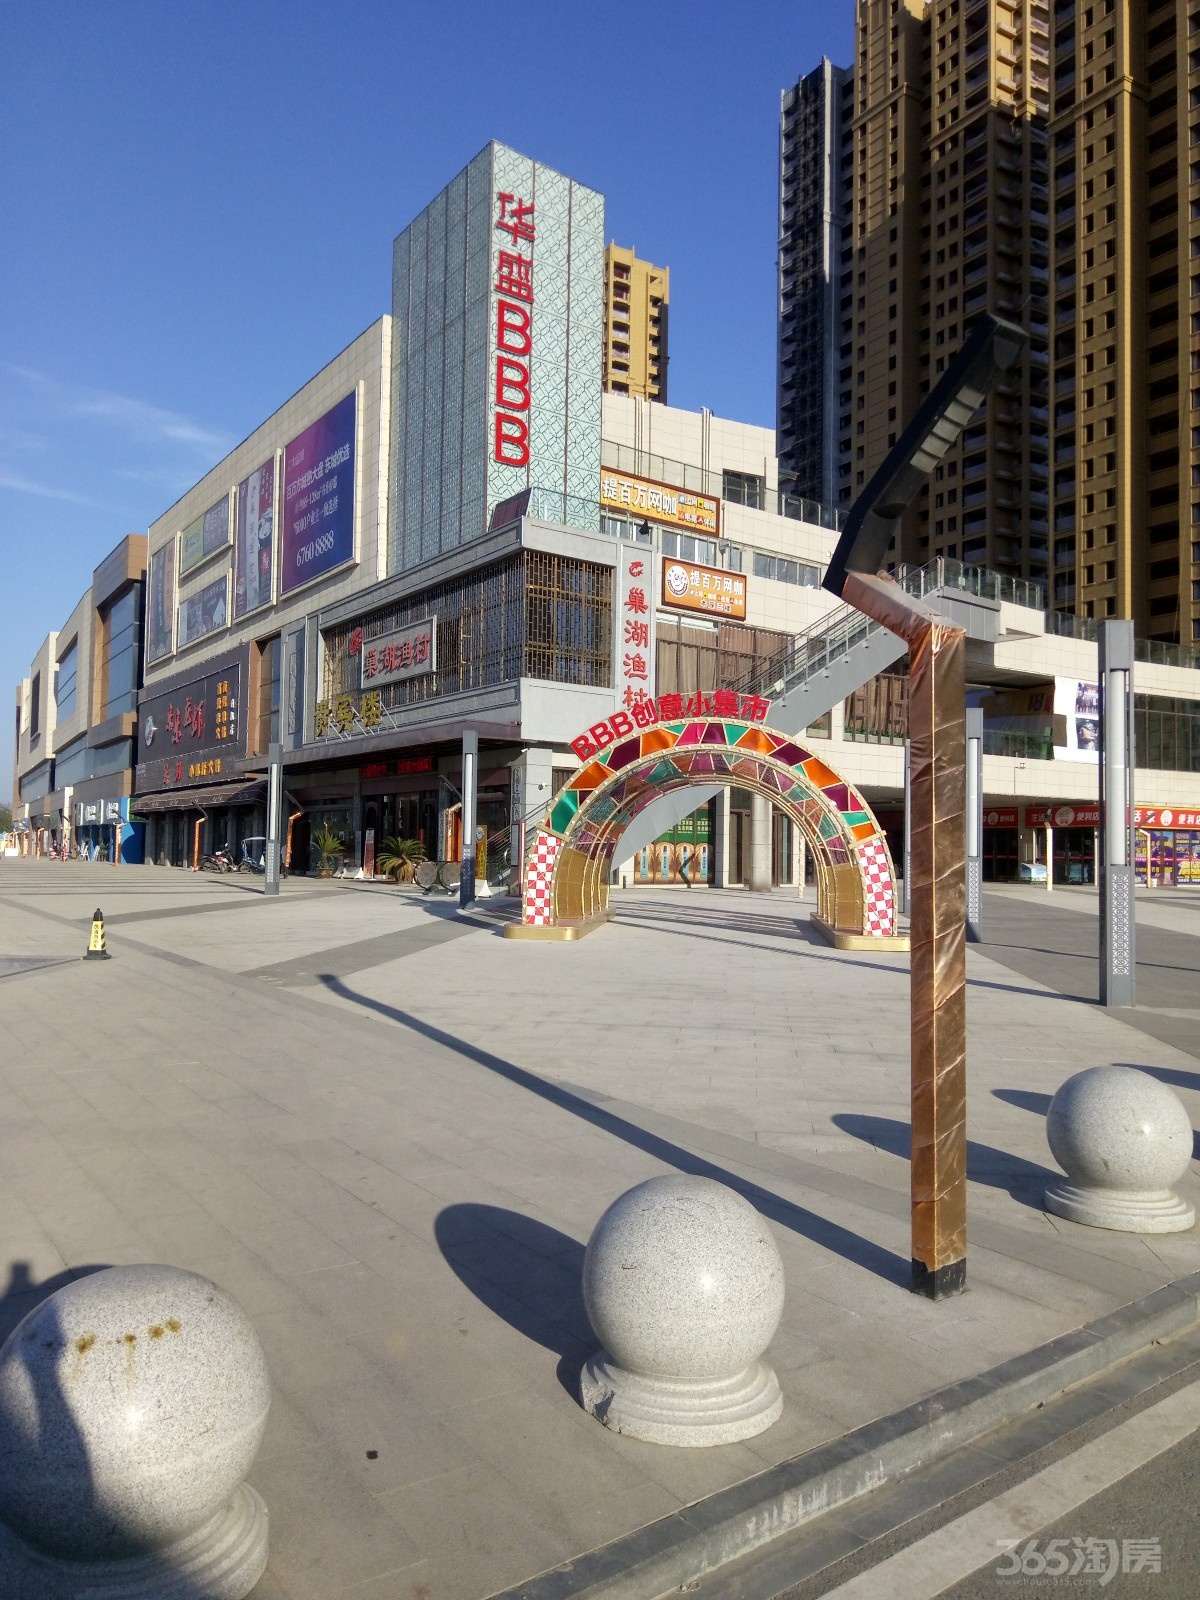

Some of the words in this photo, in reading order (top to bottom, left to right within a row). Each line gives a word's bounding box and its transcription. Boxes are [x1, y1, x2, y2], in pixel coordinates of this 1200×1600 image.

[602, 477, 677, 515] 提百万网咖
[296, 542, 314, 566] 6760
[315, 529, 334, 556] 8888
[690, 569, 743, 595] 提百万网咖
[364, 631, 432, 676] 巢湖渔村
[314, 691, 383, 737] 贵宾楼
[569, 689, 770, 762] BBB创意小集市
